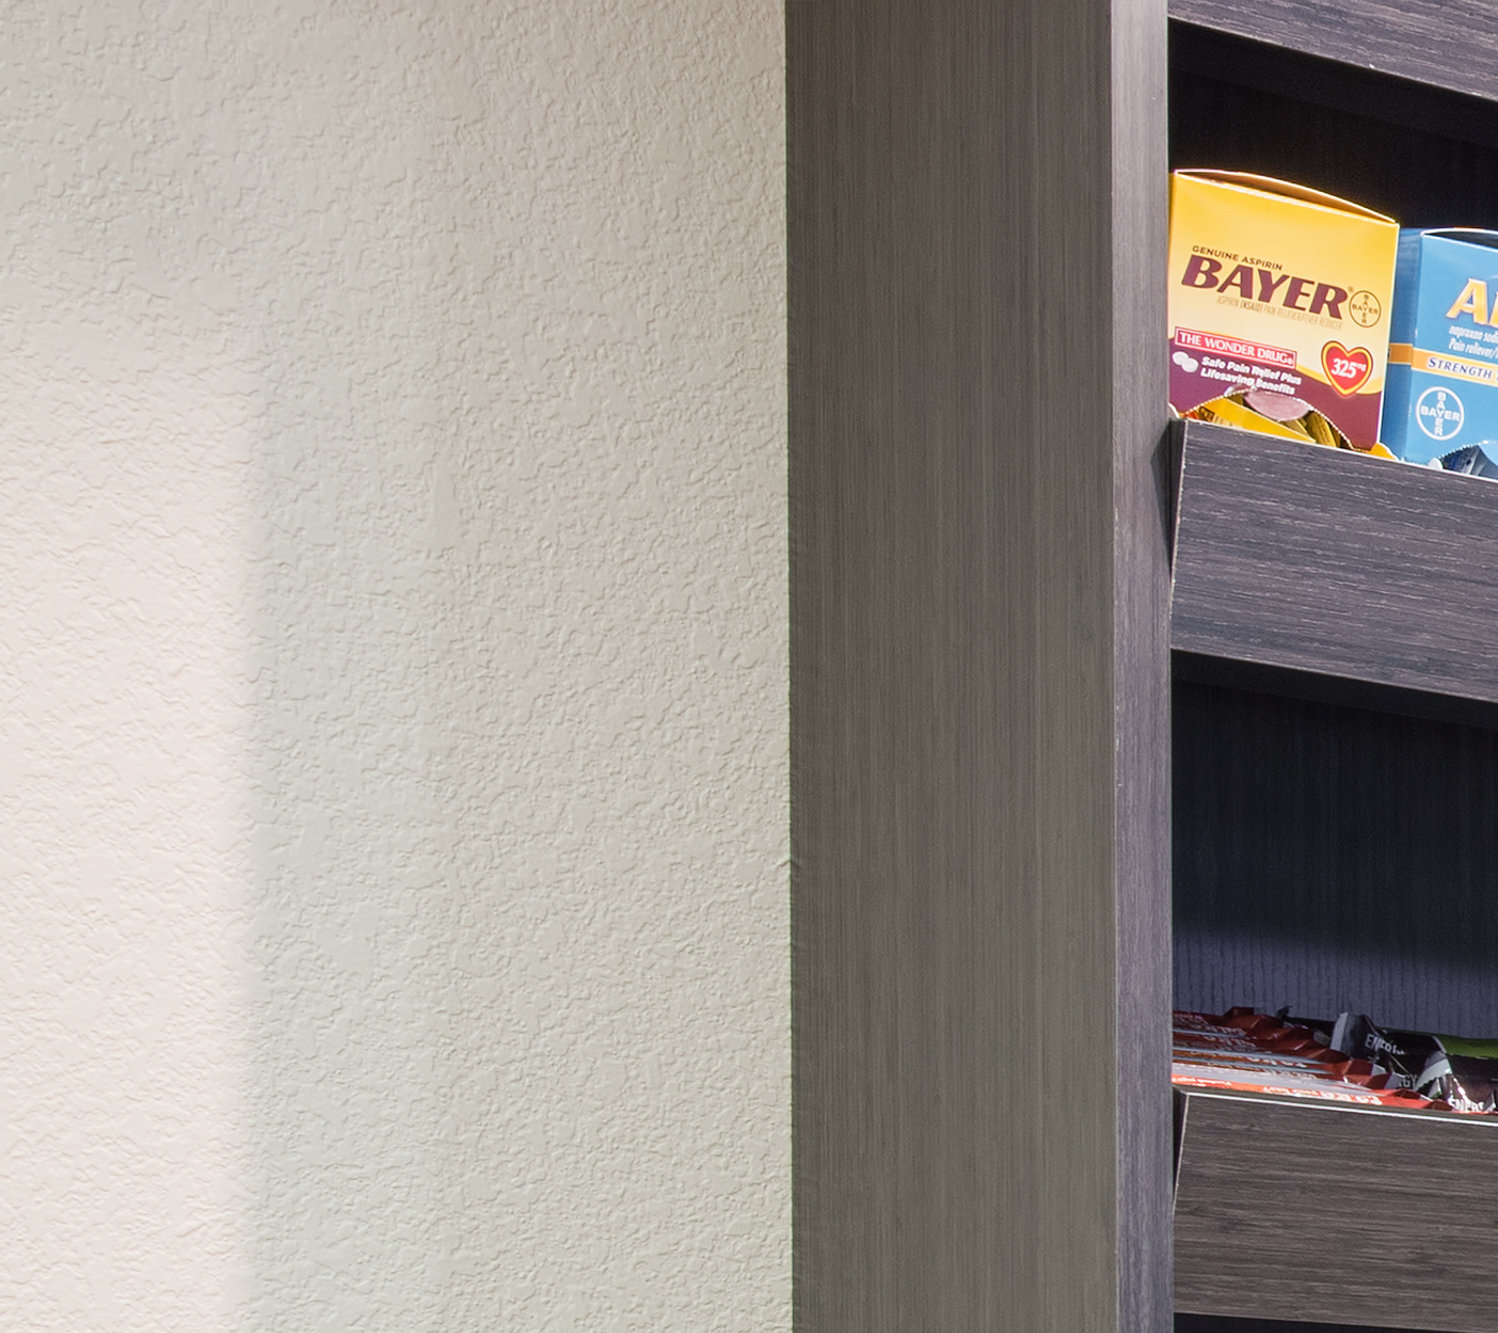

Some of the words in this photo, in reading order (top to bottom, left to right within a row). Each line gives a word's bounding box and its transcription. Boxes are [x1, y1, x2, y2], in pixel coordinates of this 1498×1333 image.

[1241, 256, 1283, 271] ASPIRIN
[1181, 254, 1348, 320] BAYER
[1179, 331, 1201, 346] THE
[1204, 335, 1255, 357] WONDER
[1428, 356, 1492, 379] STRENGTH
